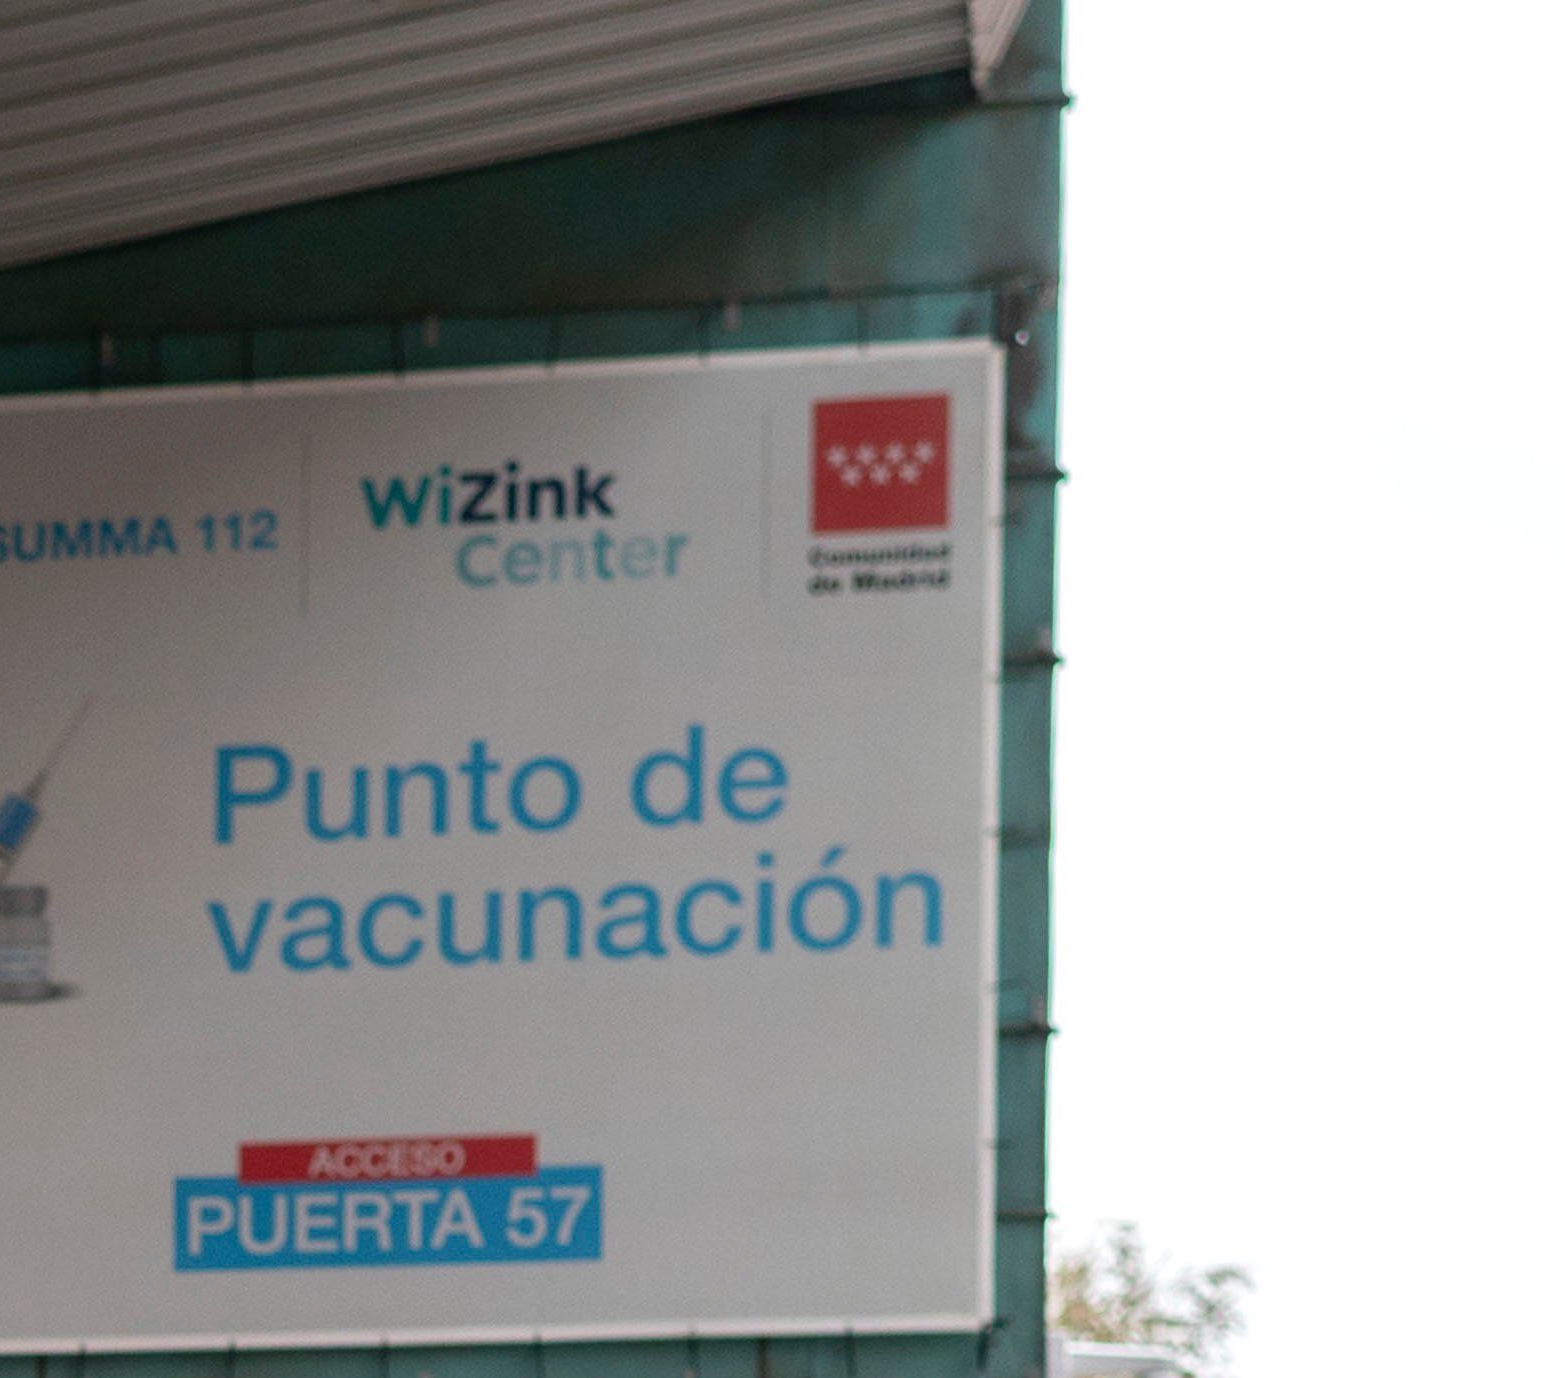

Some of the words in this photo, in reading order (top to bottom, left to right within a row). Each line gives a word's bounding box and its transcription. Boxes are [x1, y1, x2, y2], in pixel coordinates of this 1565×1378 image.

[362, 461, 616, 530] WiZink
[197, 509, 279, 553] 112
[456, 532, 689, 588] Center
[215, 740, 582, 844] Punto
[630, 724, 789, 826] de
[207, 847, 944, 974] vacunación
[308, 1140, 465, 1180] ACCESO
[186, 1190, 485, 1259] PUERTA
[506, 1185, 593, 1247] 57
